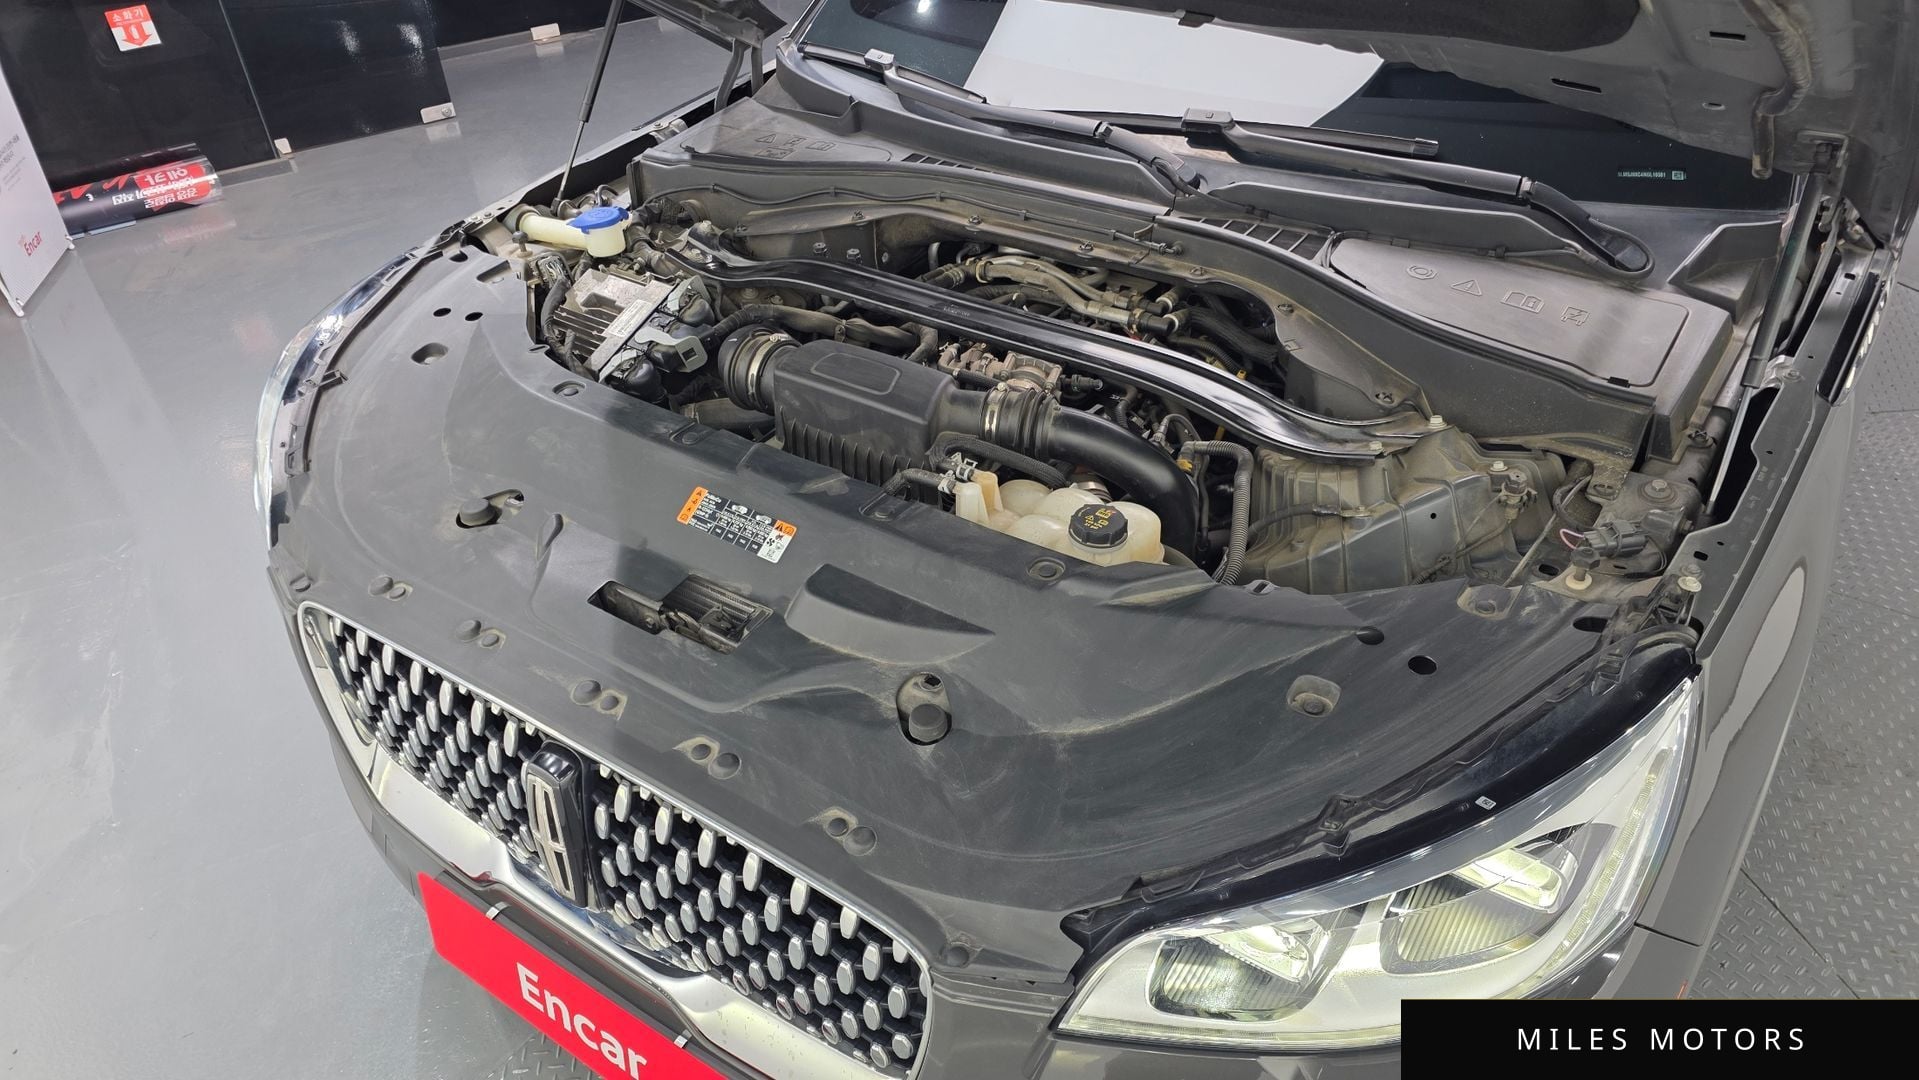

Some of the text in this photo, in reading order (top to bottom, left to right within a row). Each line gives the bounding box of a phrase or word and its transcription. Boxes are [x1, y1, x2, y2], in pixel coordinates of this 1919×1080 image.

[112, 8, 144, 22] 소화기
[23, 230, 43, 257] Encar
[516, 962, 648, 1080] Encar
